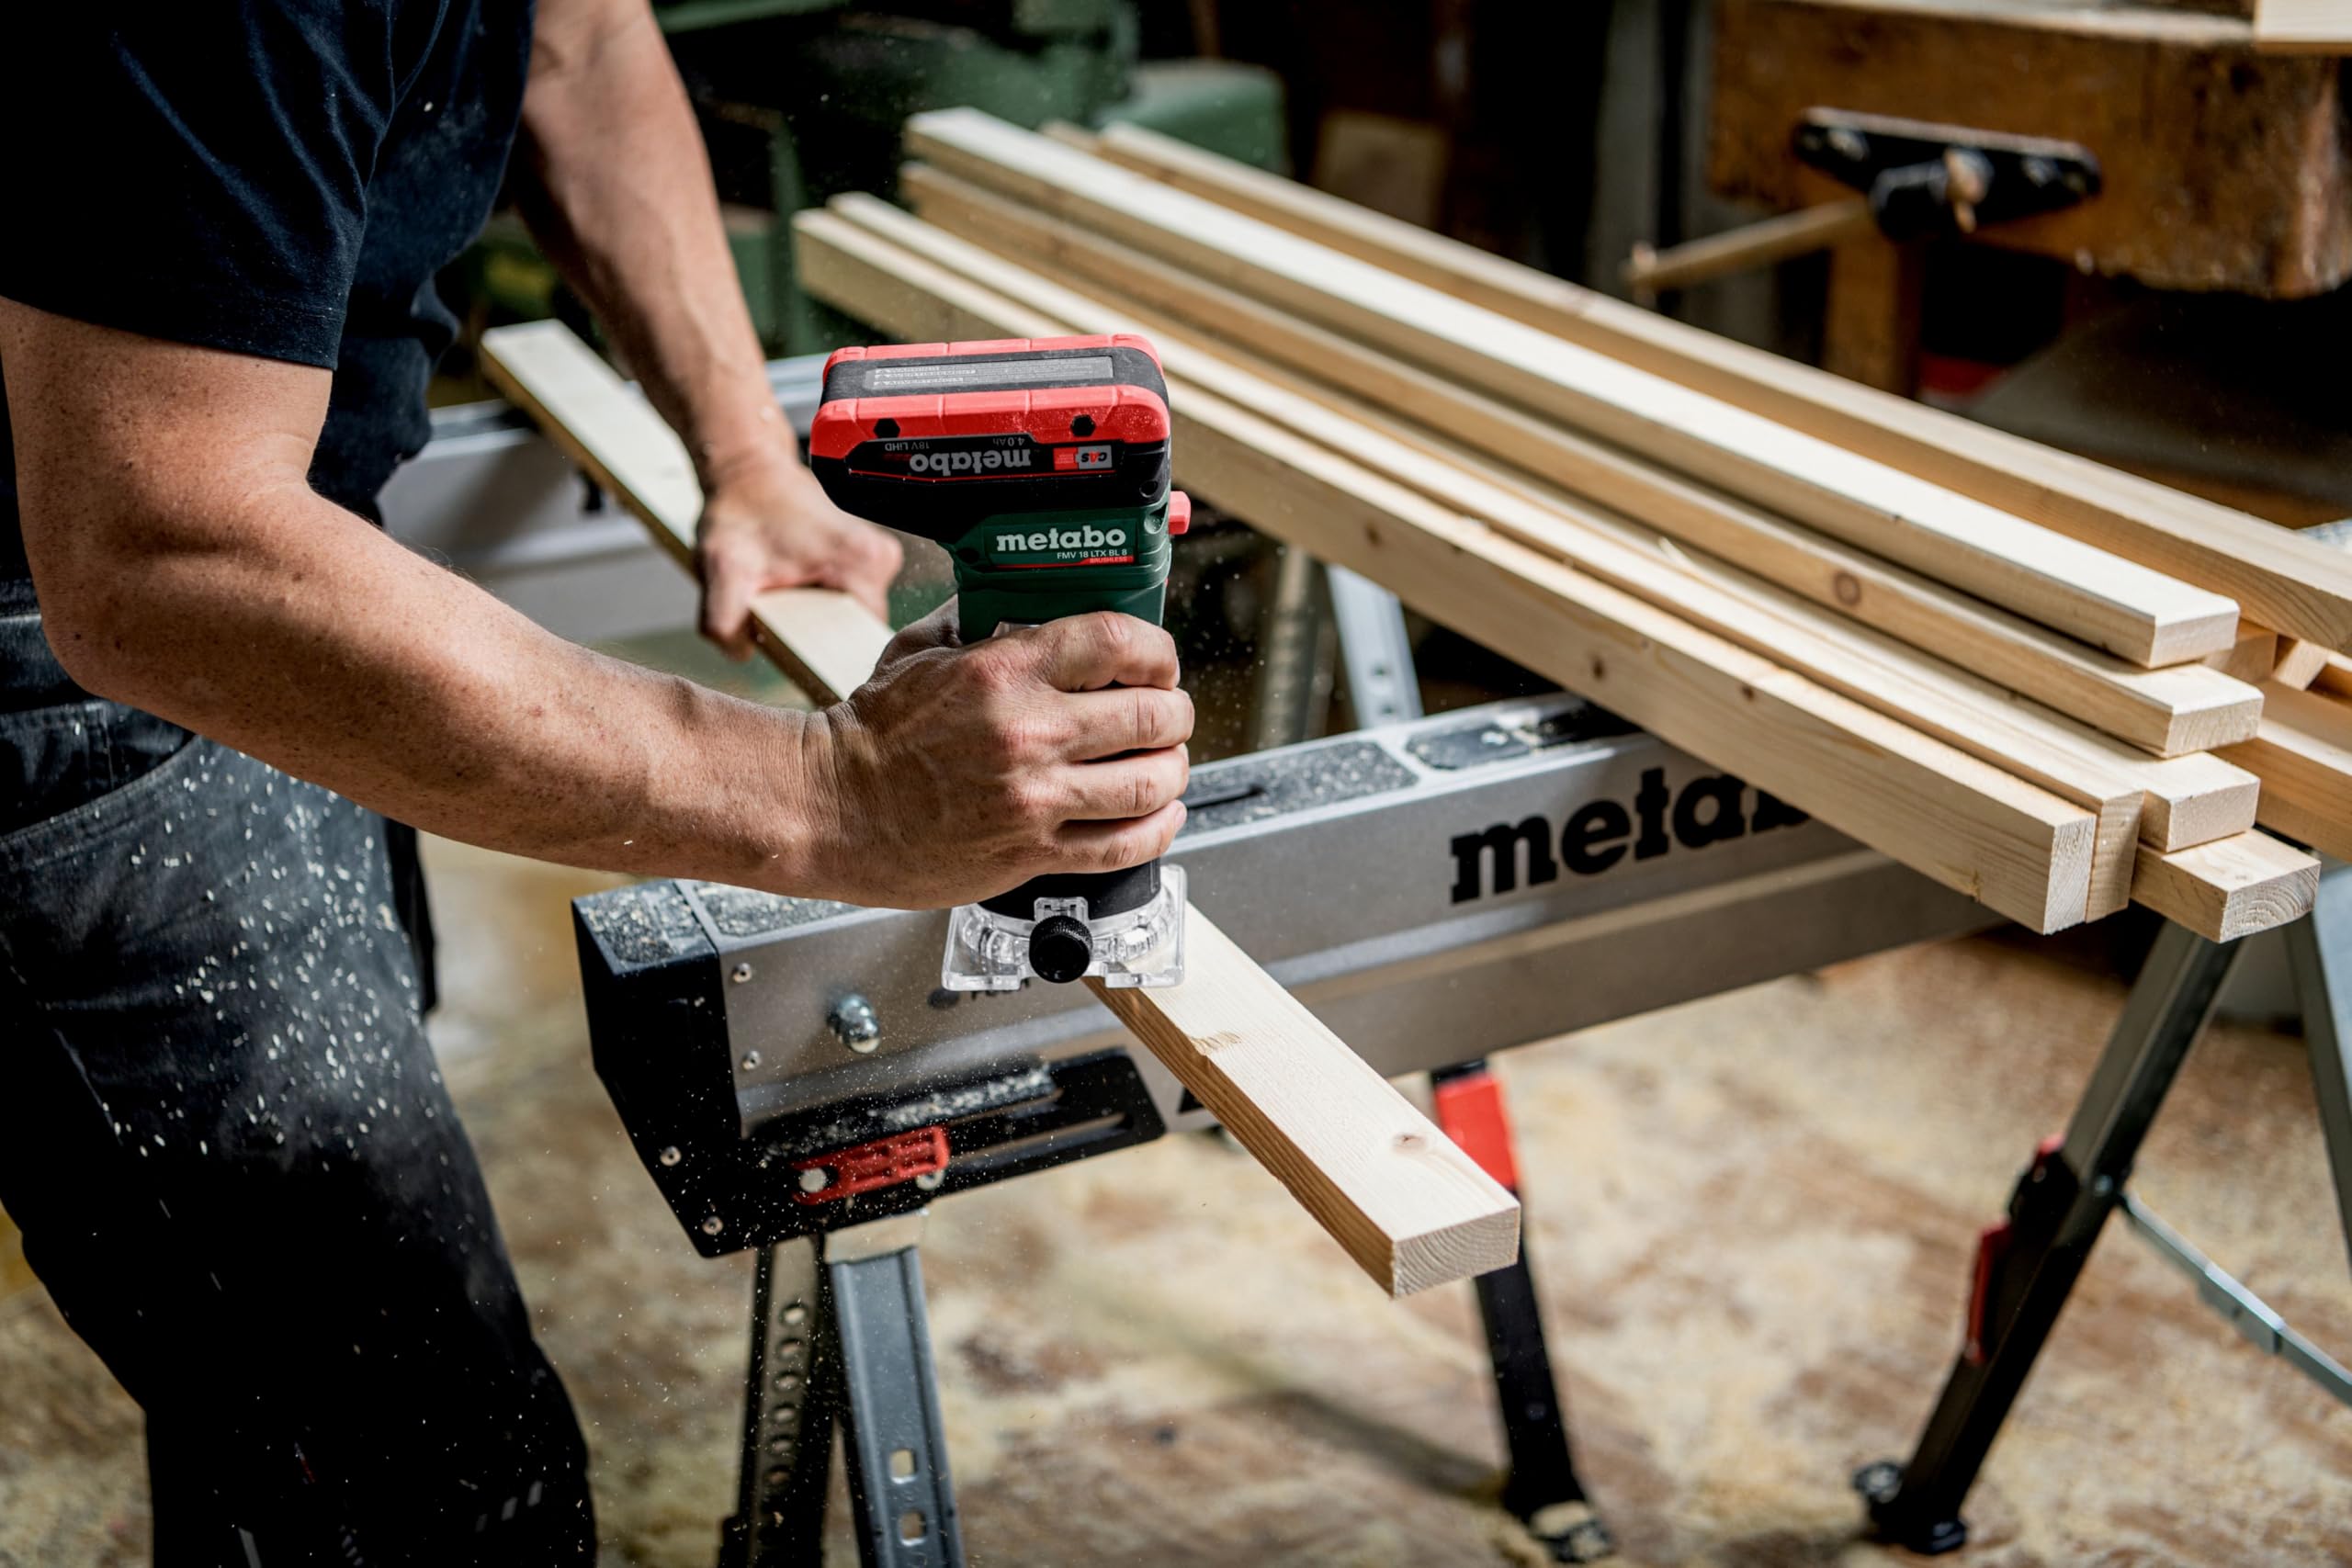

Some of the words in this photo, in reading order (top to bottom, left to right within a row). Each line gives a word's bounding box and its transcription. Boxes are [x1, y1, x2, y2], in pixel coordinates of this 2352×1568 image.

[885, 442, 909, 451] LiHD
[911, 441, 930, 450] 18V
[909, 449, 1031, 476] metabo
[1080, 451, 1107, 464] CAS
[996, 525, 1126, 551] metabo
[1057, 551, 1077, 559] FMV
[1079, 550, 1089, 558] 18
[1091, 549, 1107, 558] LTX
[1108, 548, 1120, 557] BL
